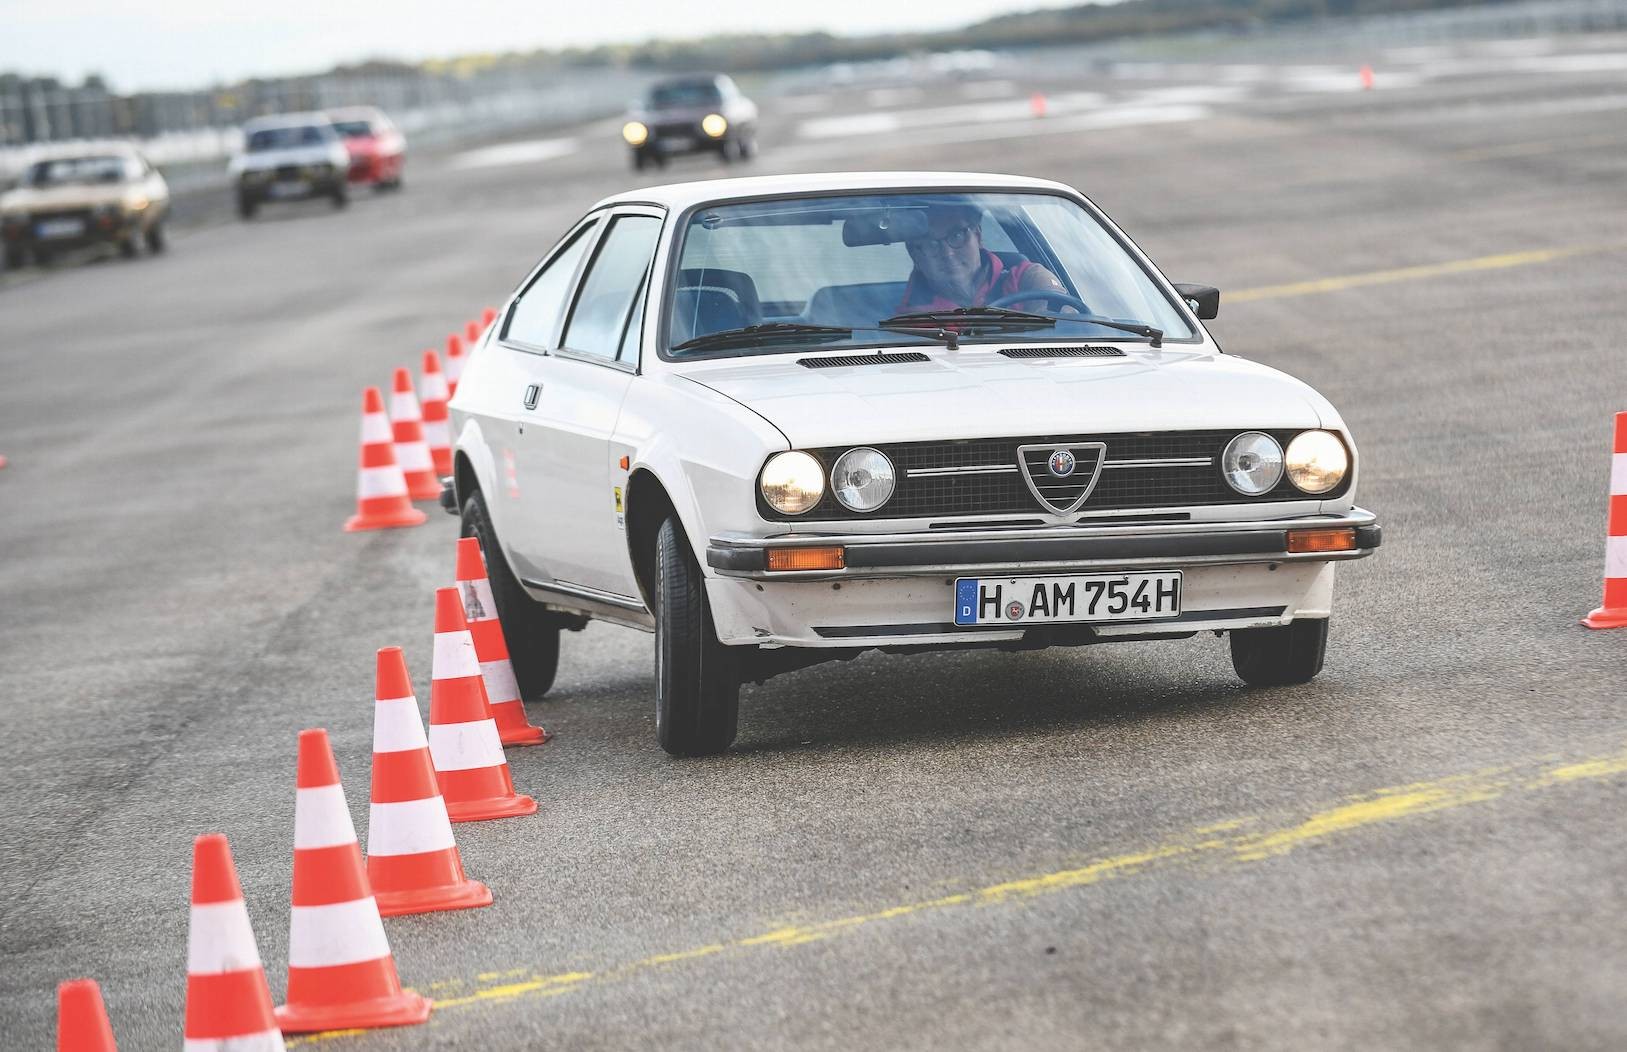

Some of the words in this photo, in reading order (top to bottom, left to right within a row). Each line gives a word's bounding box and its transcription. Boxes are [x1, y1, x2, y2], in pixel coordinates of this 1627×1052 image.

[962, 606, 971, 617] D
[979, 585, 1002, 619] H
[1028, 583, 1076, 618] AM
[1085, 578, 1179, 615] 754H
